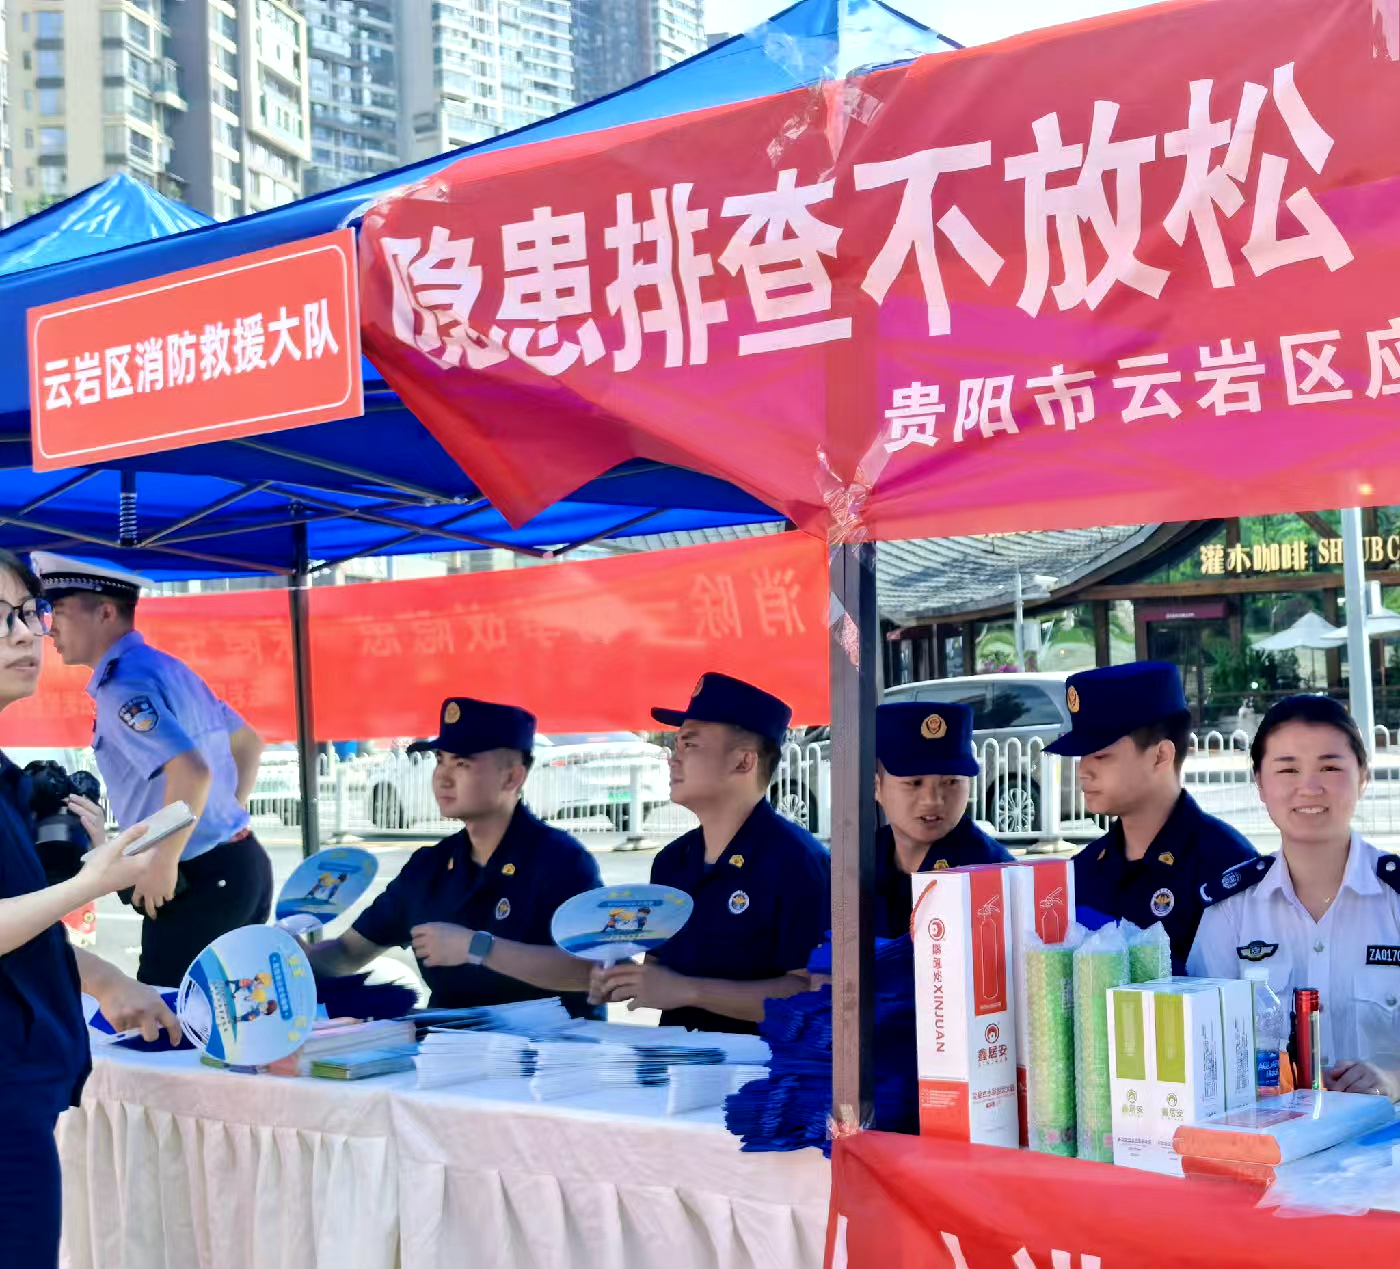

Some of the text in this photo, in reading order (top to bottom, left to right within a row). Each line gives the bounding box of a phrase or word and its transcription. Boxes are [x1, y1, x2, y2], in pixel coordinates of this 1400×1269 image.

[380, 61, 1355, 377] 隐患排查不放松
[43, 298, 339, 410] 云岩区消防救援大队
[1200, 541, 1308, 575] 灌木咖啡
[1318, 536, 1384, 565] SHUB
